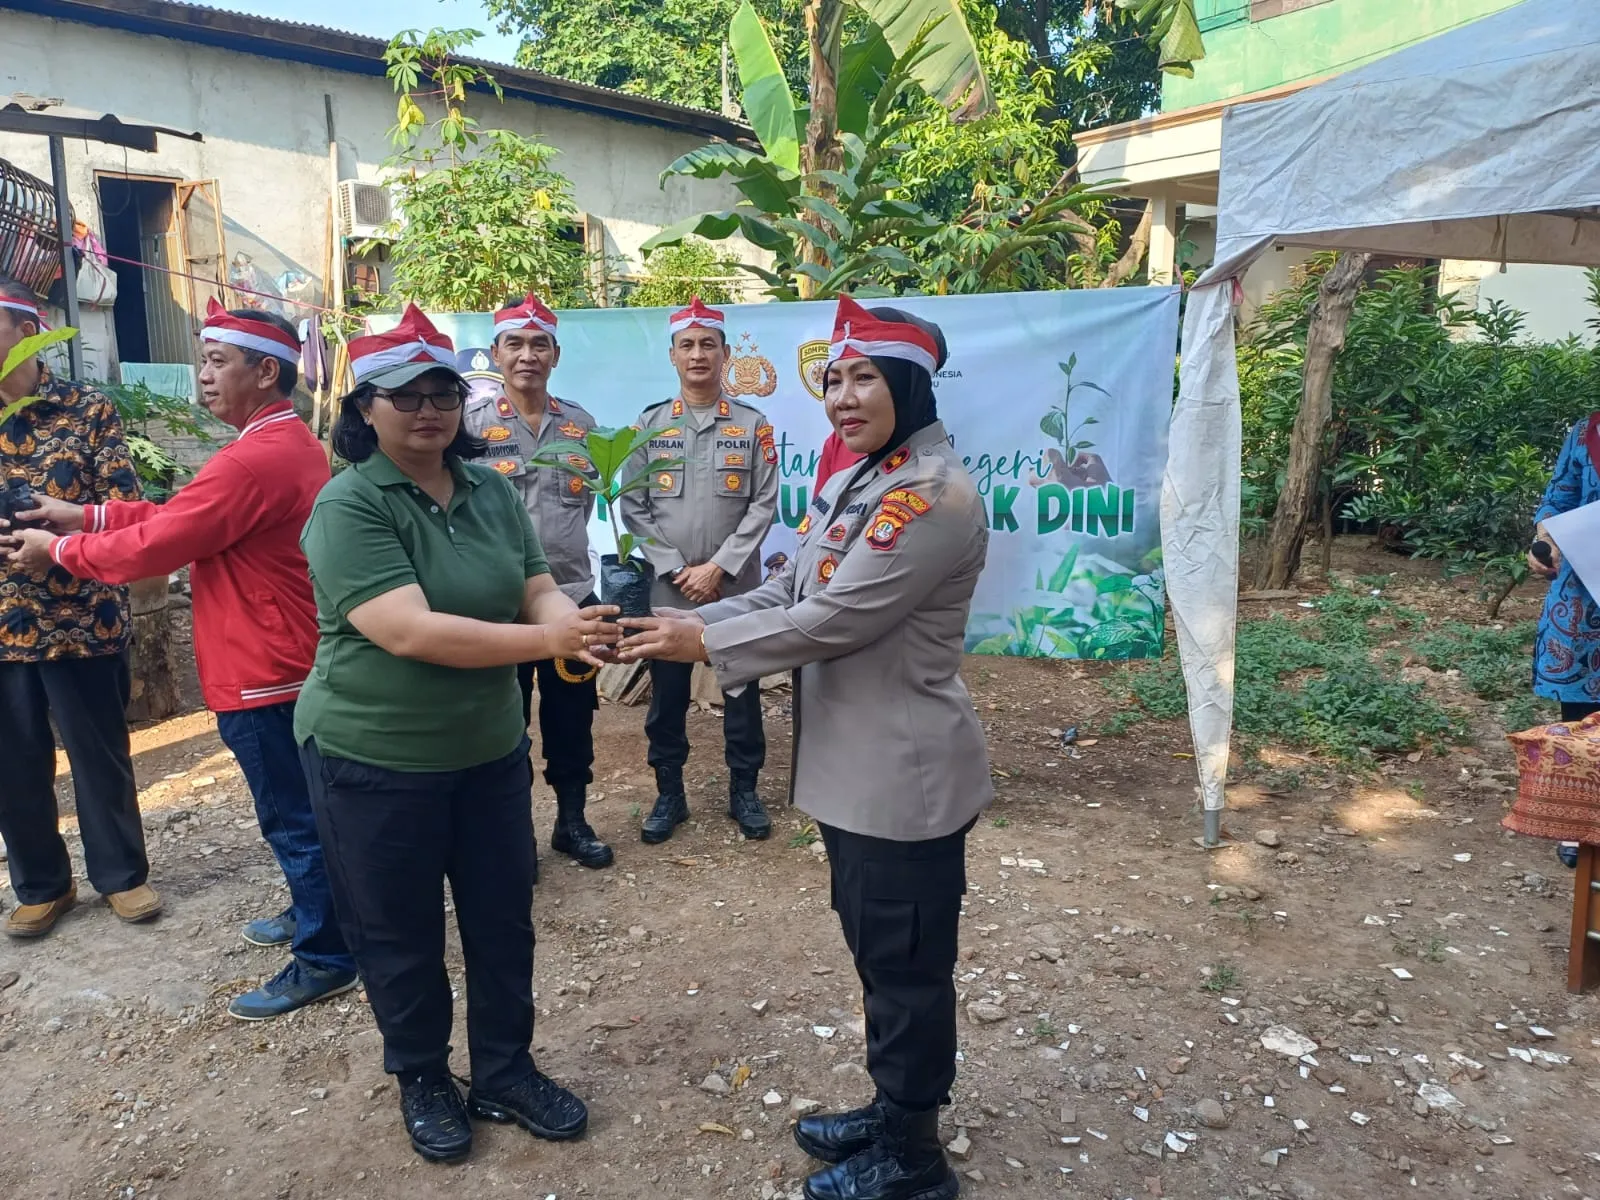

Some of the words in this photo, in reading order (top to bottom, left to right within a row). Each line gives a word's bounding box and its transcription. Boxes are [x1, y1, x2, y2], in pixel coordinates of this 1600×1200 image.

[932, 370, 962, 379] NESIA
[648, 440, 684, 450] RUSLAN
[716, 440, 750, 450] POLRI
[962, 449, 1053, 496] egeri
[1037, 482, 1135, 539] DINI
